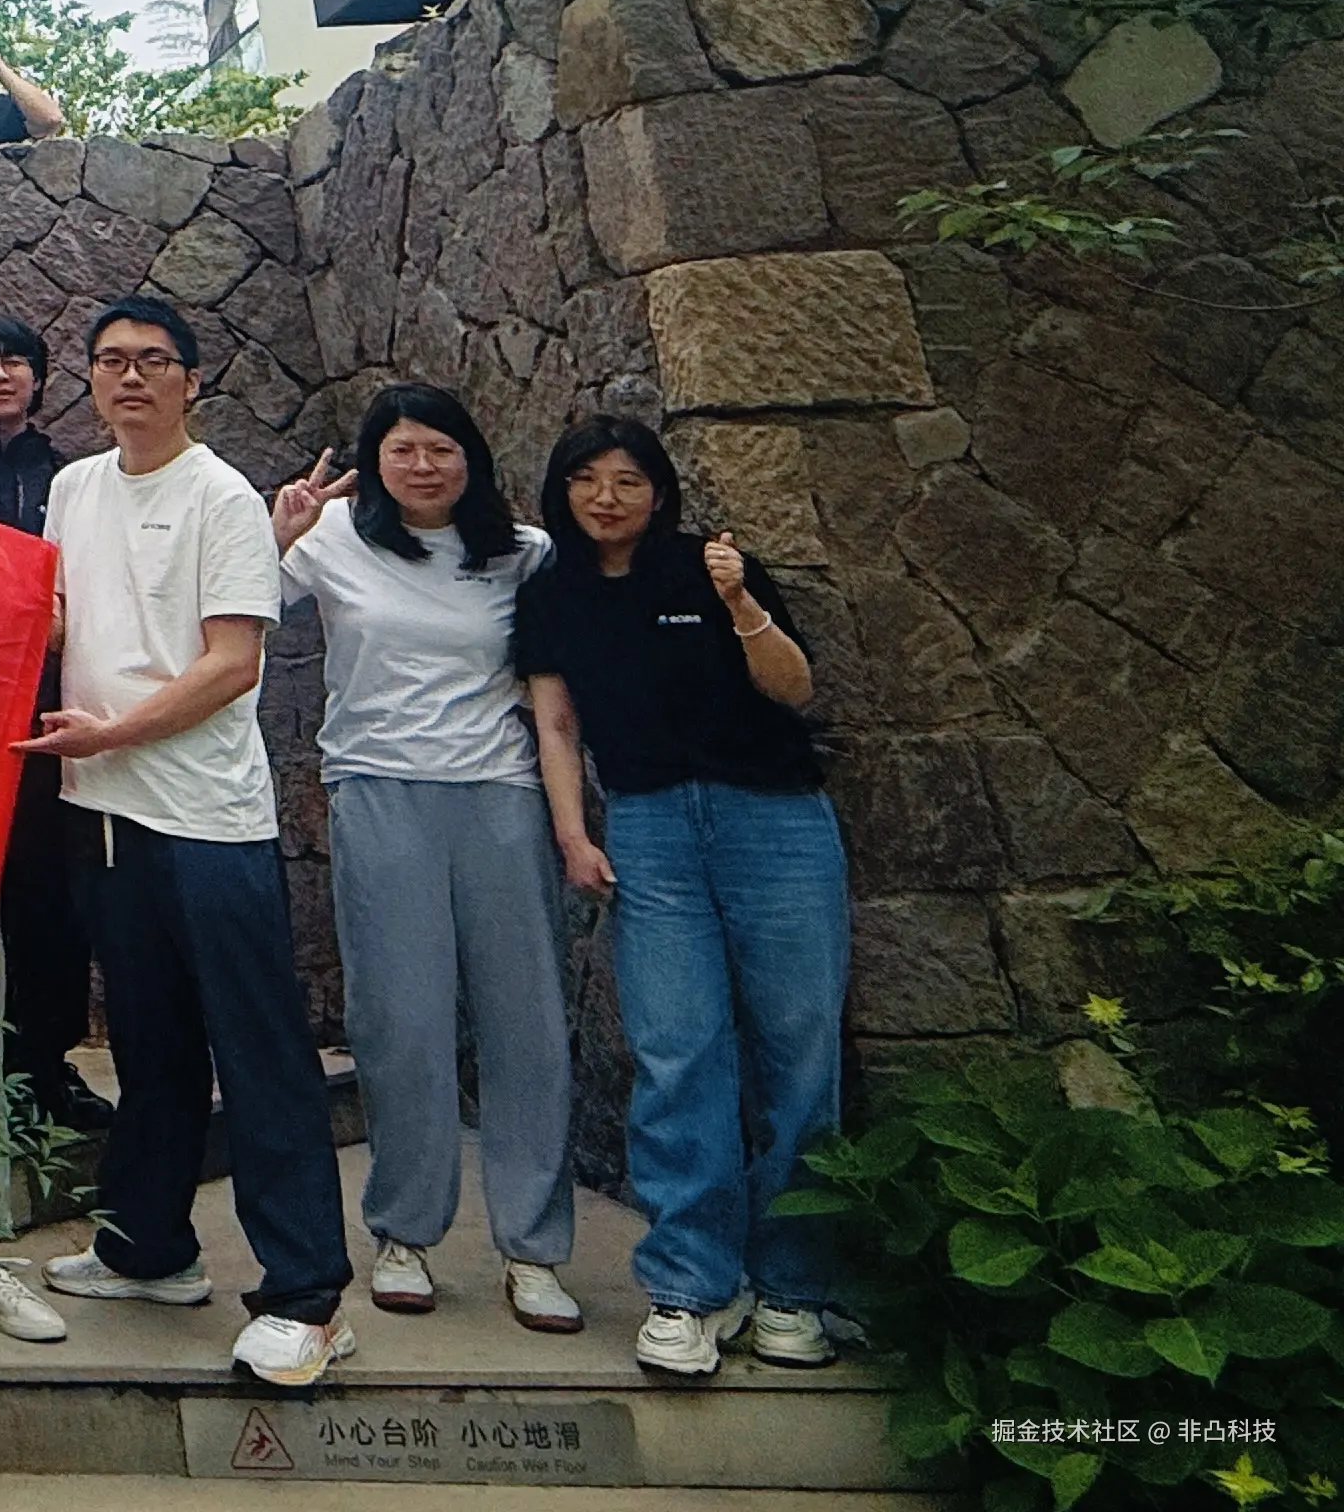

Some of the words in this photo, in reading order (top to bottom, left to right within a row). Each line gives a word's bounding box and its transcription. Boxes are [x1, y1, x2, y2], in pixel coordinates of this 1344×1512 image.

[318, 1416, 439, 1447] 小心台阶
[461, 1419, 581, 1450] 小心地滑
[367, 1454, 401, 1468] Your
[407, 1454, 440, 1471] Step
